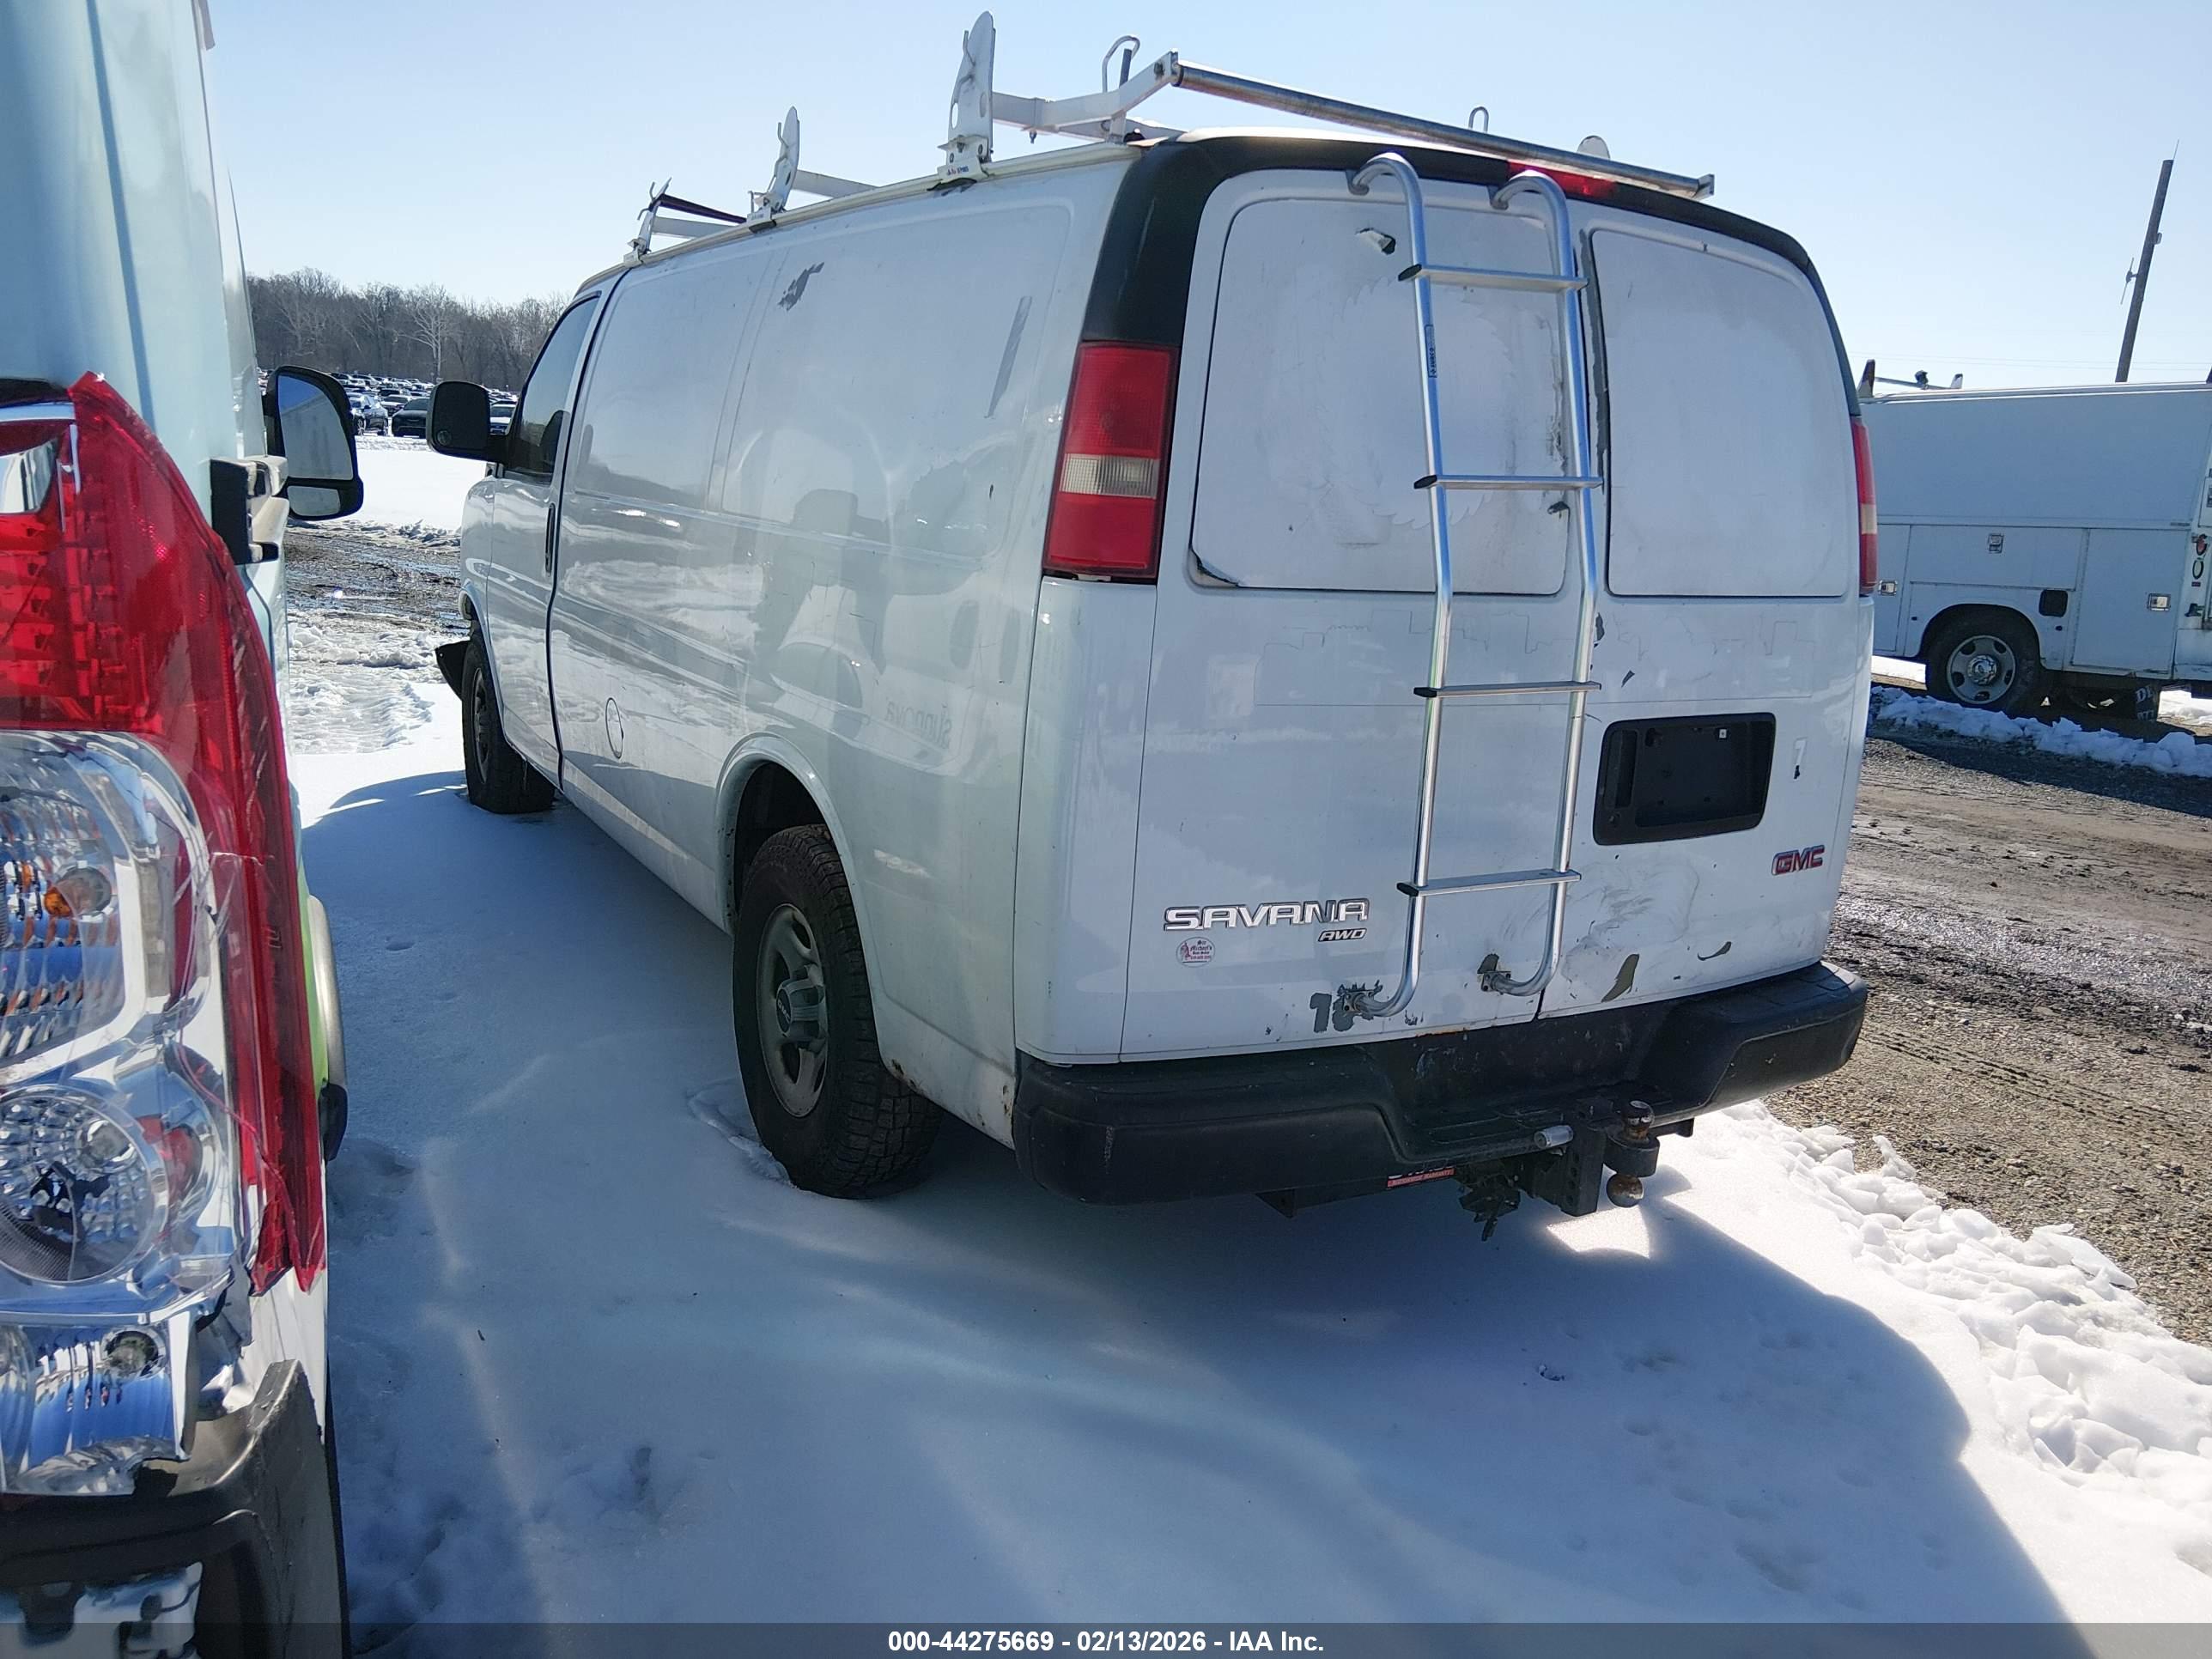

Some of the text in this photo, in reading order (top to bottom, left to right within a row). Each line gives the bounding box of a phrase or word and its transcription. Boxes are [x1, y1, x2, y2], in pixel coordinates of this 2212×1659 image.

[1771, 844, 1825, 876] GMC
[1164, 898, 1370, 931] SAVANA
[1320, 928, 1366, 943] AWD
[777, 999, 791, 1024] GMC
